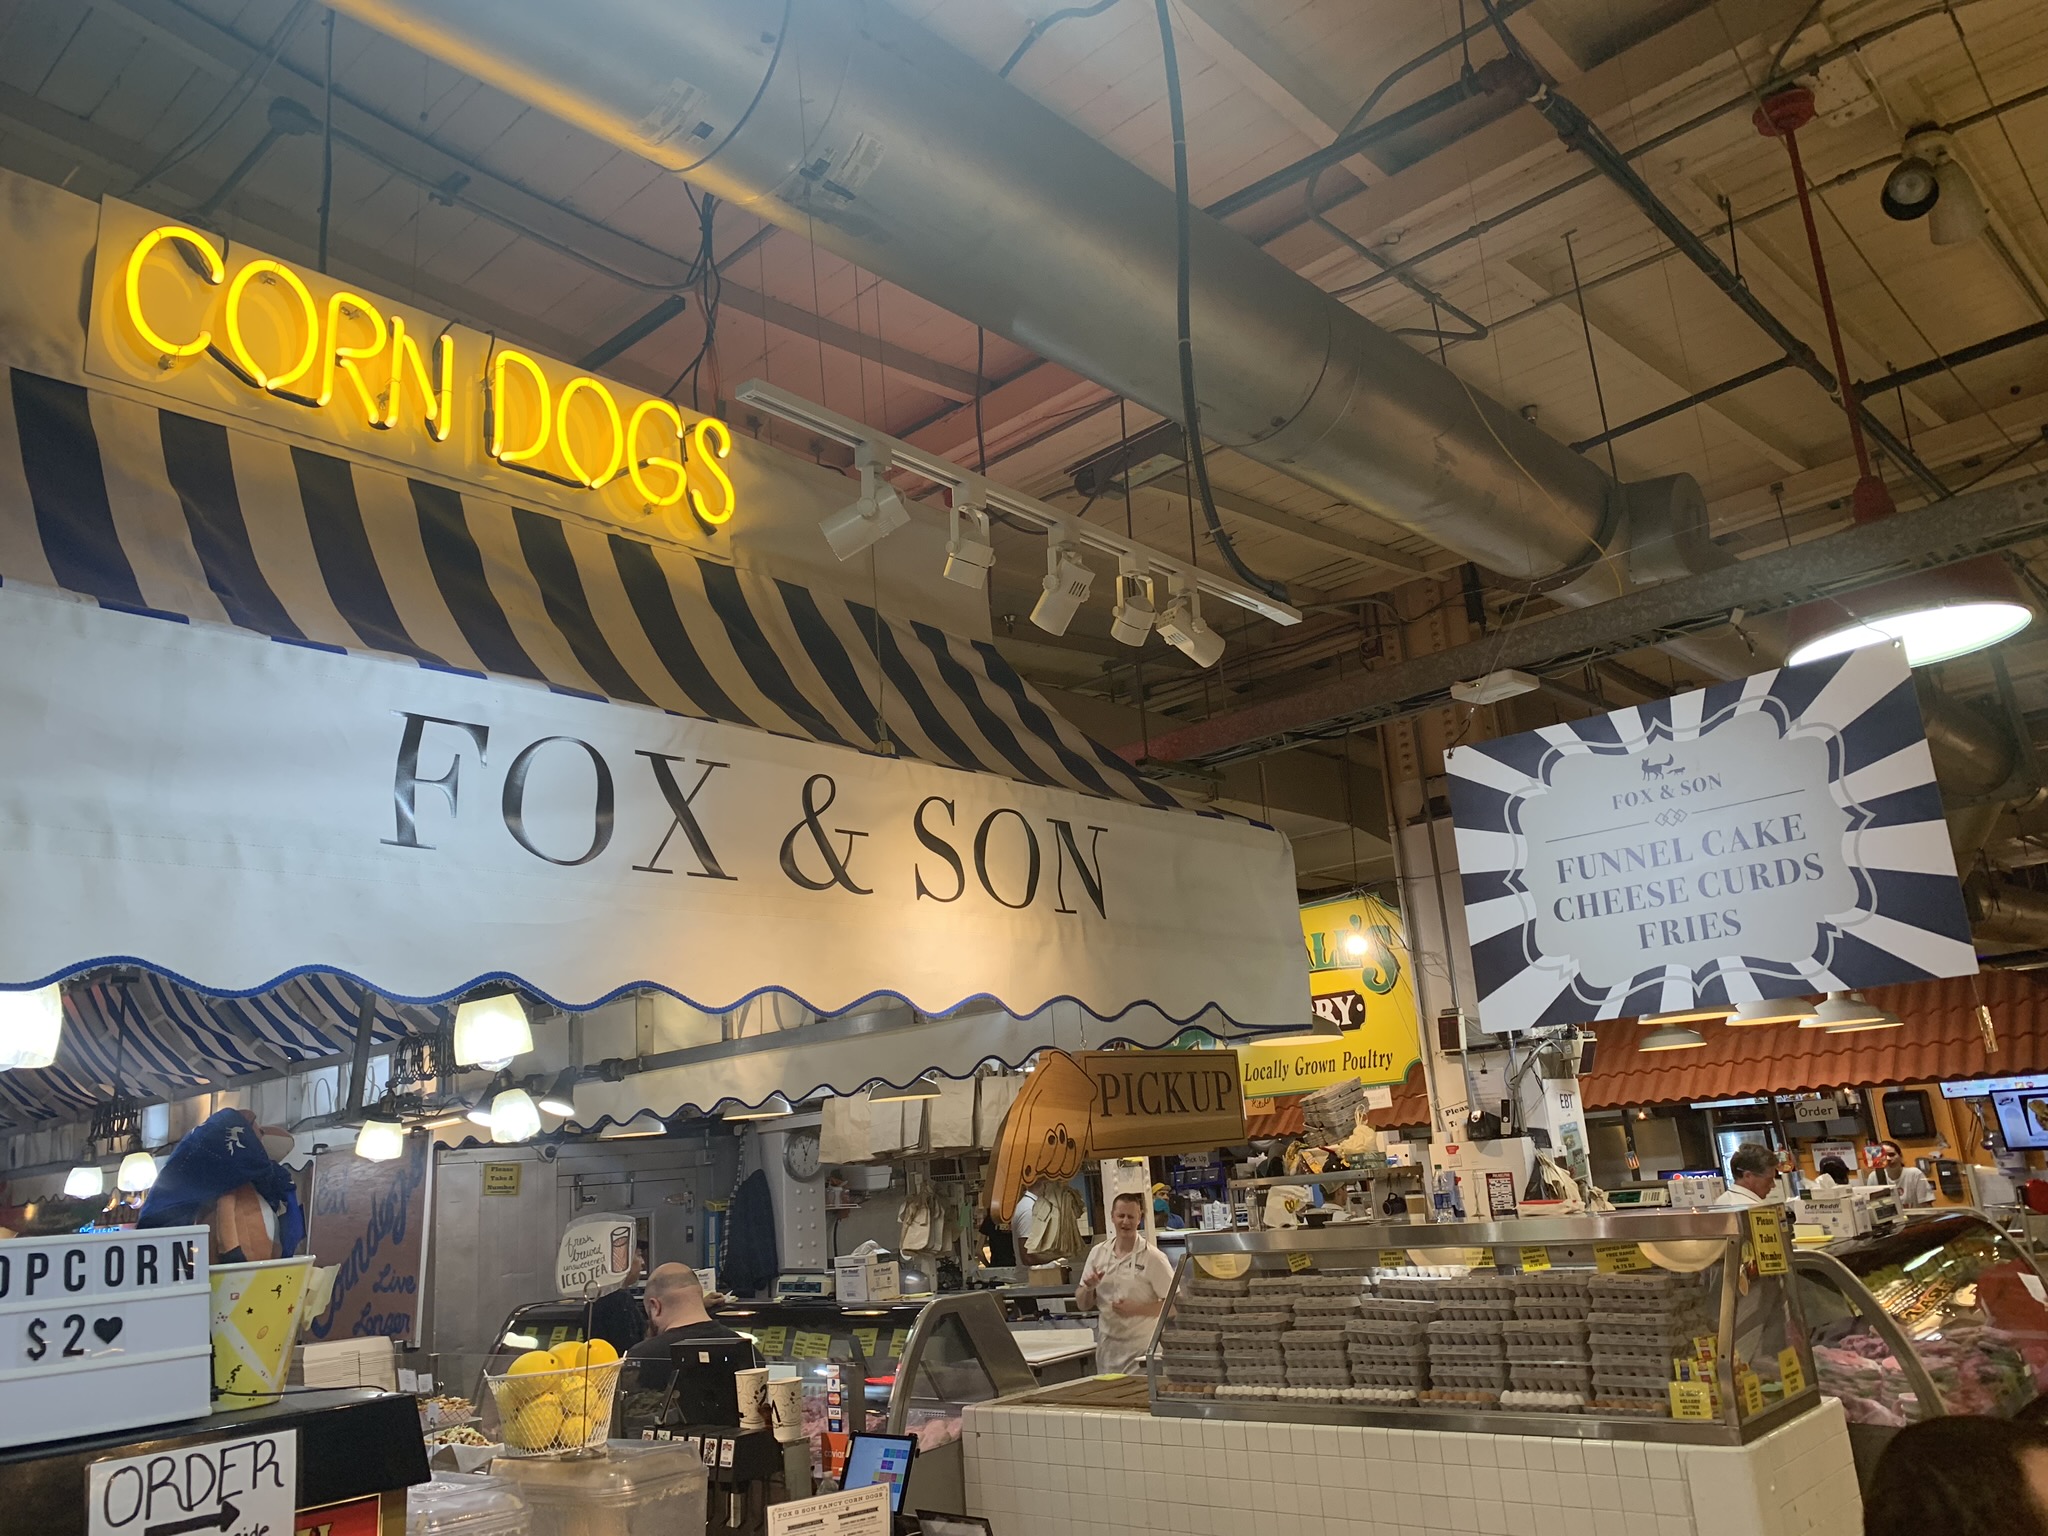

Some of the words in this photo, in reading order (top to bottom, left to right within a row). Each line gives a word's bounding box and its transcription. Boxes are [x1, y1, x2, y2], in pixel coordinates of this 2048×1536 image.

[126, 225, 453, 442] CORN
[491, 349, 736, 526] DOGS
[1612, 790, 1655, 811] FOX
[1659, 783, 1676, 799] &
[1680, 772, 1723, 795] SON
[380, 710, 738, 881] FOX
[779, 774, 874, 895] &
[914, 796, 1108, 920] SON
[1556, 836, 1694, 884] FUNNEL
[1701, 813, 1807, 857] CAKE
[1553, 877, 1689, 923] CHEESE
[1697, 852, 1825, 895] CURDS
[1638, 908, 1742, 950] FRIES
[1303, 914, 1401, 994] LL'S
[1312, 995, 1356, 1026] RY
[1244, 1059, 1289, 1083] Locally
[1295, 1056, 1336, 1077] Grown
[1342, 1049, 1393, 1072] Poultry
[1097, 1069, 1233, 1118] PICKUP
[1559, 1093, 1573, 1109] EBT
[1444, 1105, 1470, 1117] Pleas
[1798, 1105, 1834, 1118] Order
[1755, 1216, 1775, 1226] Please
[564, 1235, 594, 1258] fresh
[570, 1243, 603, 1263] brewed
[1759, 1233, 1773, 1243] Take
[563, 1254, 606, 1272] unsweetened
[1760, 1251, 1782, 1261] Number
[372, 1263, 417, 1295] Live
[561, 1271, 587, 1289] ICED
[587, 1263, 608, 1281] TEA
[104, 1439, 284, 1527] ORDER
[778, 1510, 793, 1519] FOX
[801, 1505, 817, 1514] SON
[818, 1500, 843, 1511] FANCY
[844, 1496, 863, 1504] CORN
[865, 1491, 883, 1500] DOGS
